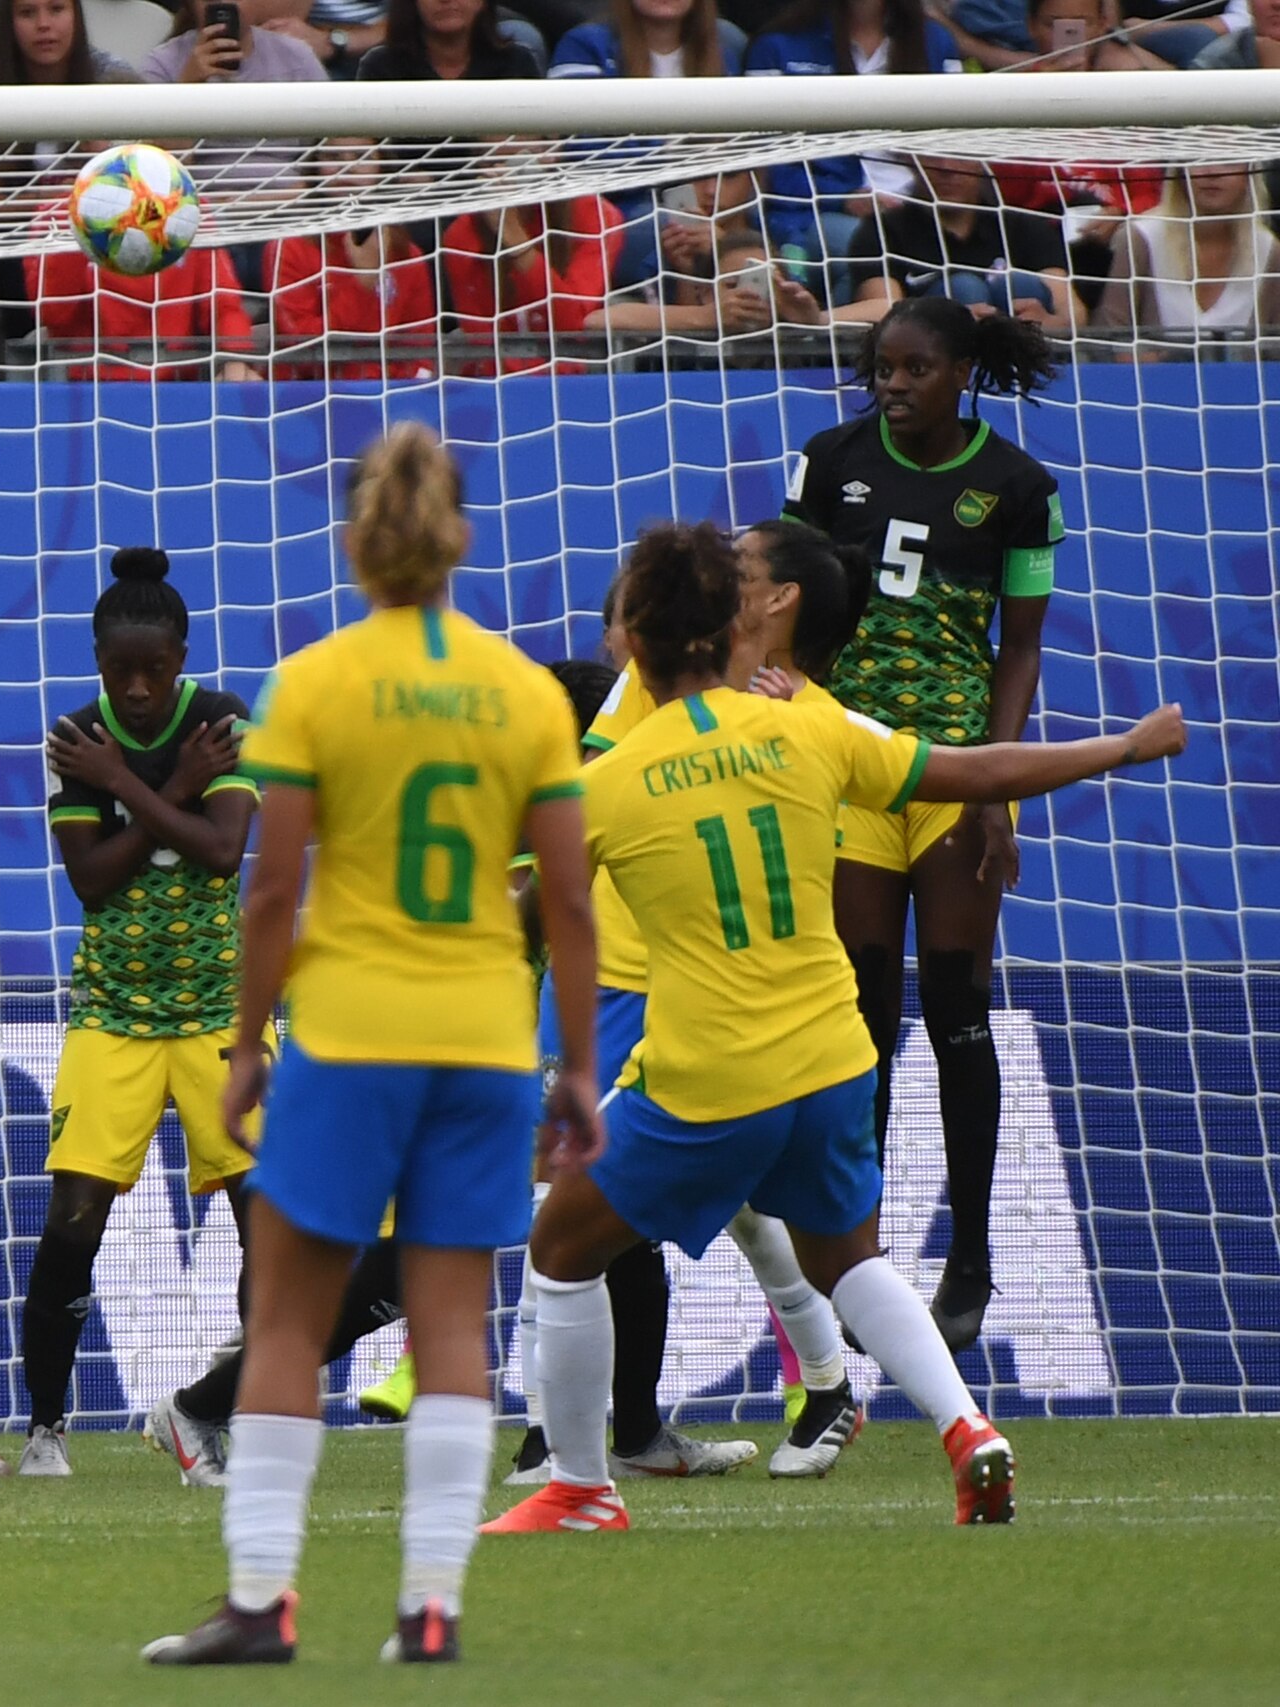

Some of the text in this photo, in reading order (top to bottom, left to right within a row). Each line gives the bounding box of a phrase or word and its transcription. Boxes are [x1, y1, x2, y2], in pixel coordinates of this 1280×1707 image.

[879, 518, 930, 598] 5
[643, 736, 793, 798] CRISTIANE
[396, 762, 479, 924] 6
[695, 804, 796, 951] 11
